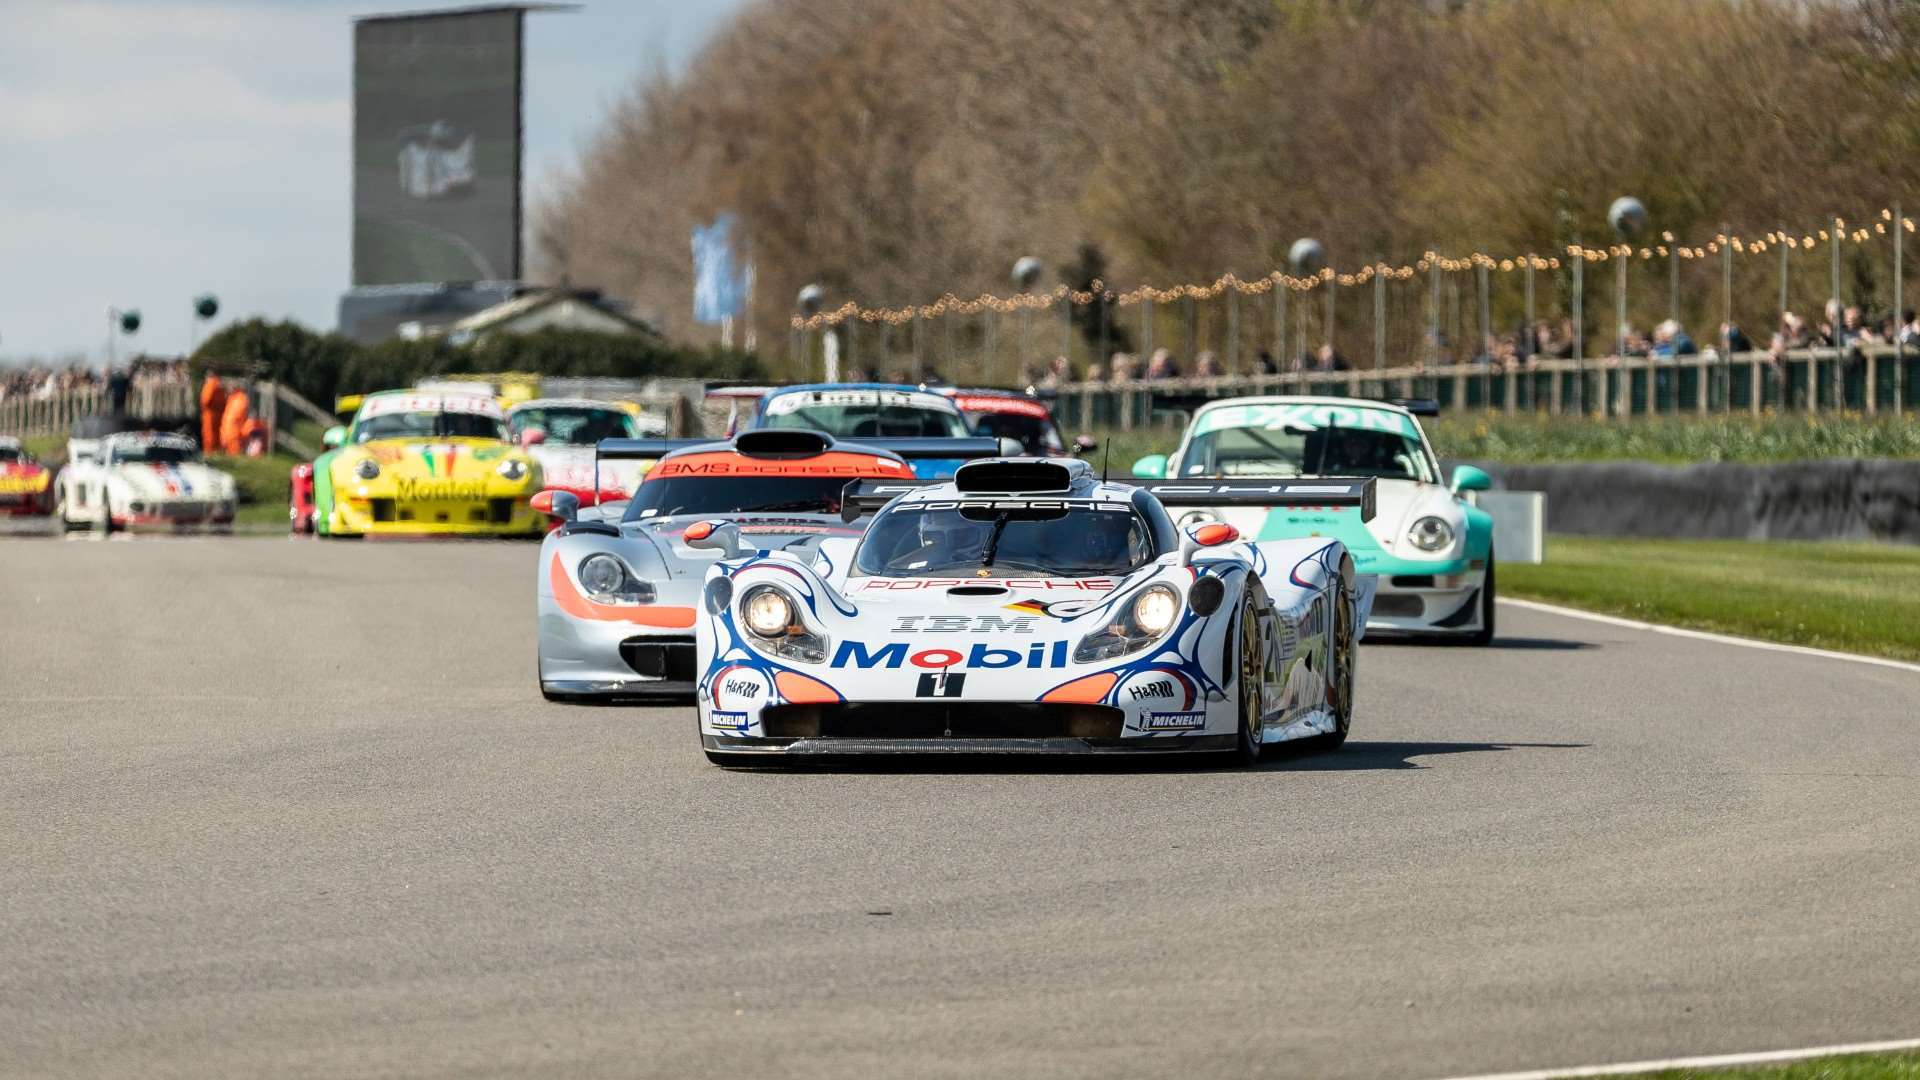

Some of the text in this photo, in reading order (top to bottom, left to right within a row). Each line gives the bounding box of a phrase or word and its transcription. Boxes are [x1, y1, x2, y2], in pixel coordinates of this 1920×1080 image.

[1210, 404, 1404, 432] EXXON
[660, 463, 730, 475] BMS
[892, 502, 1131, 513] PORSCHE
[862, 579, 1114, 592] PORSCHE
[890, 615, 1041, 634] IBM
[829, 640, 1069, 669] Mobil
[1152, 715, 1206, 727] MICHELIN
